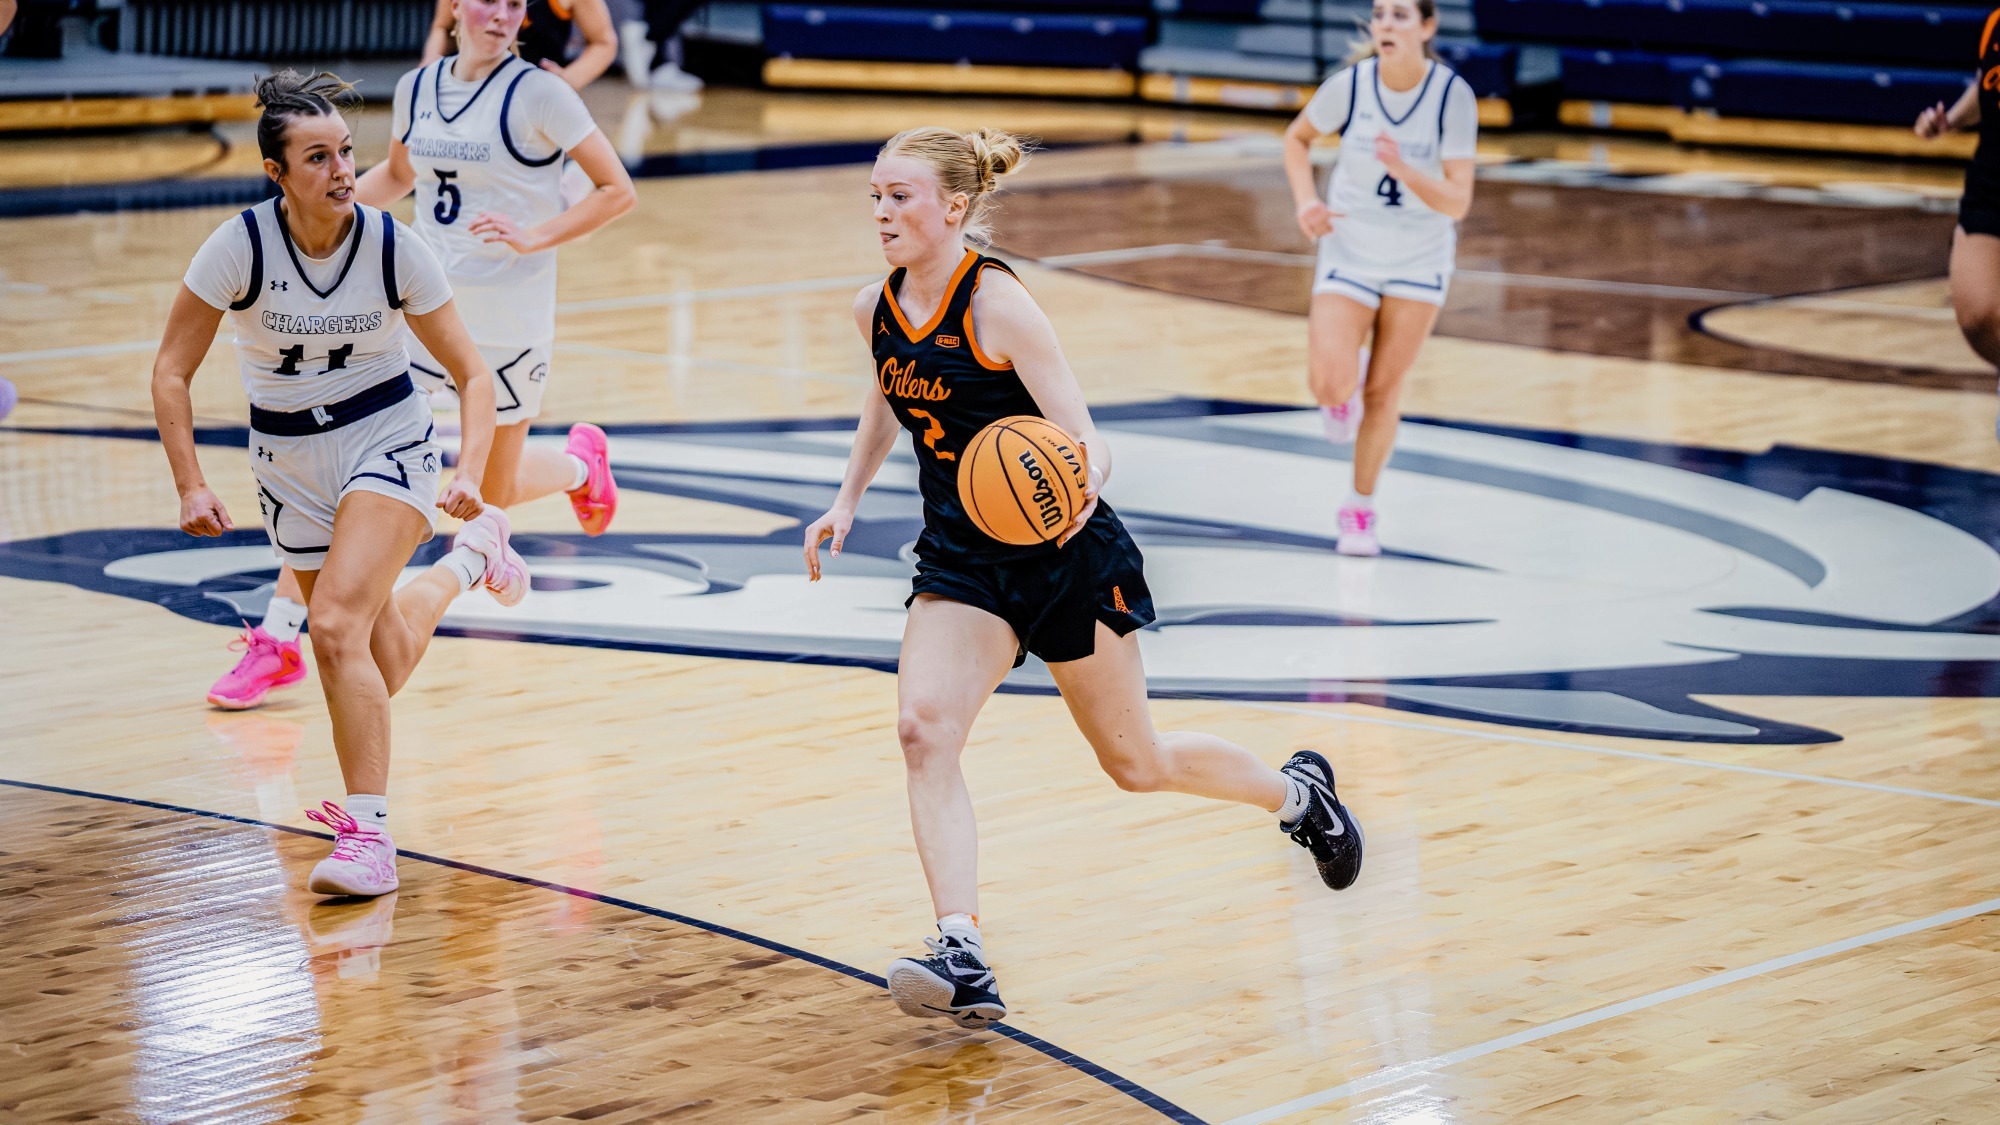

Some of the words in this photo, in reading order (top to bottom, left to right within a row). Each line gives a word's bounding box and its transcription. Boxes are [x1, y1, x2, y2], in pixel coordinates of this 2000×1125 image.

[433, 167, 462, 225] 5
[1377, 173, 1402, 206] 4
[261, 310, 382, 335] CHARGERS
[272, 343, 354, 376] 11
[880, 356, 952, 401] Oilers
[907, 408, 956, 462] 2
[1018, 448, 1064, 531] Wilson
